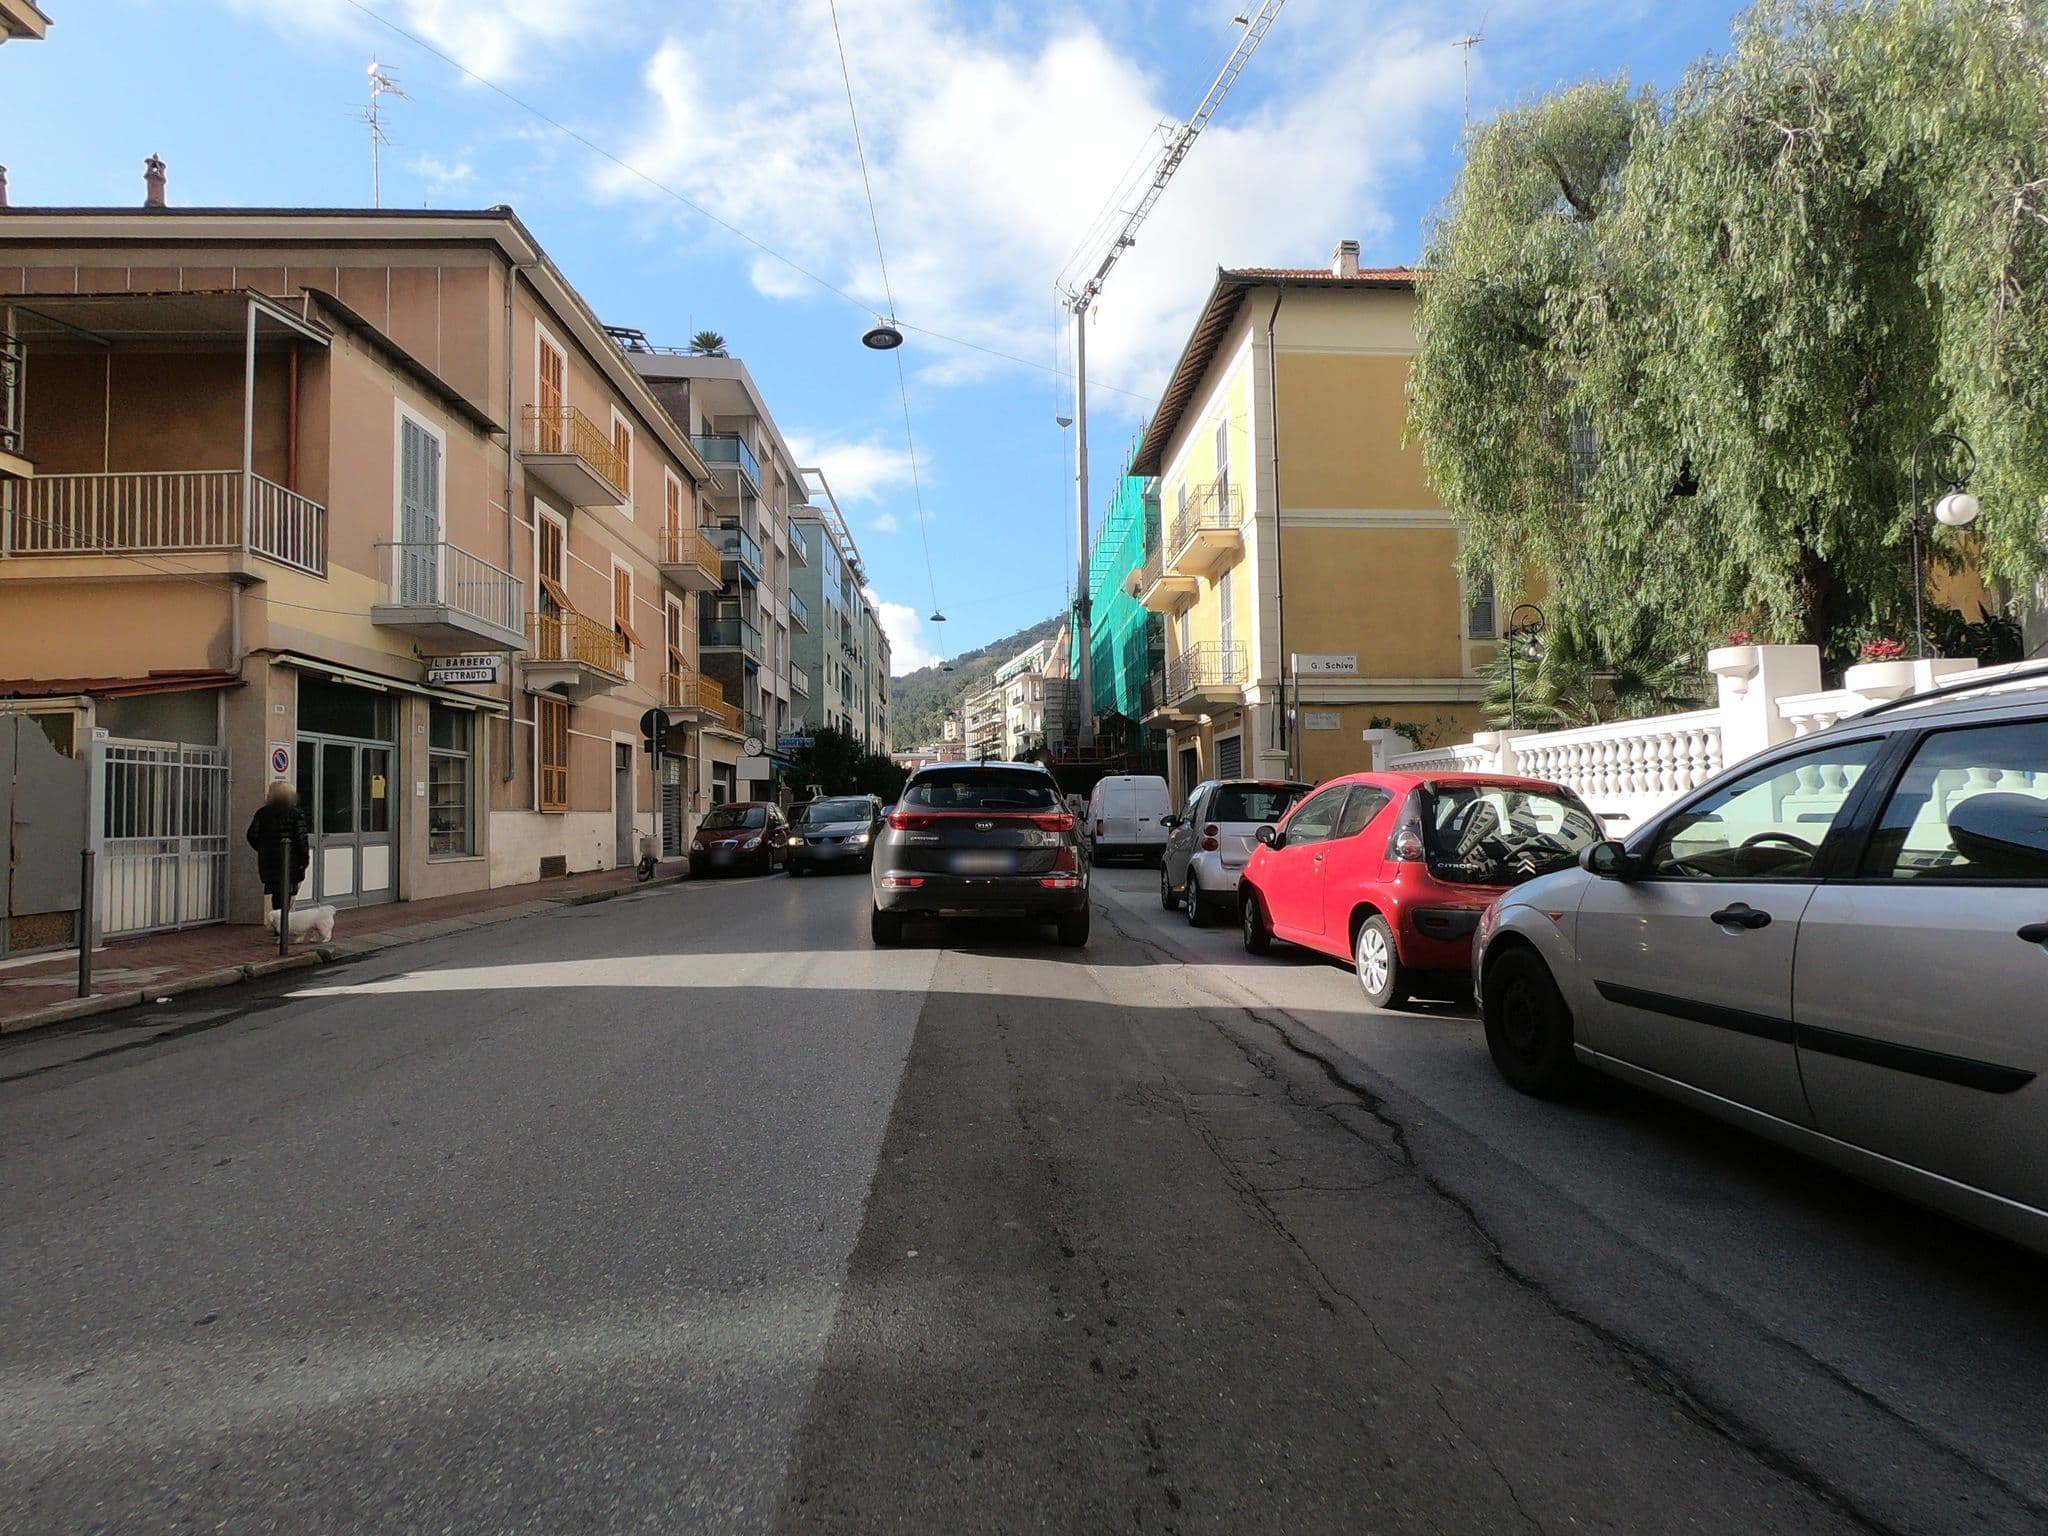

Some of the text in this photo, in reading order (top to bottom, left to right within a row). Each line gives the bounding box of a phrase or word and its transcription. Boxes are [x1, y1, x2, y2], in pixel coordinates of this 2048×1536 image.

[434, 658, 492, 668] L. BARBERO
[1311, 662, 1354, 670] G. Schivo
[433, 671, 487, 681] ELETTRAUTO
